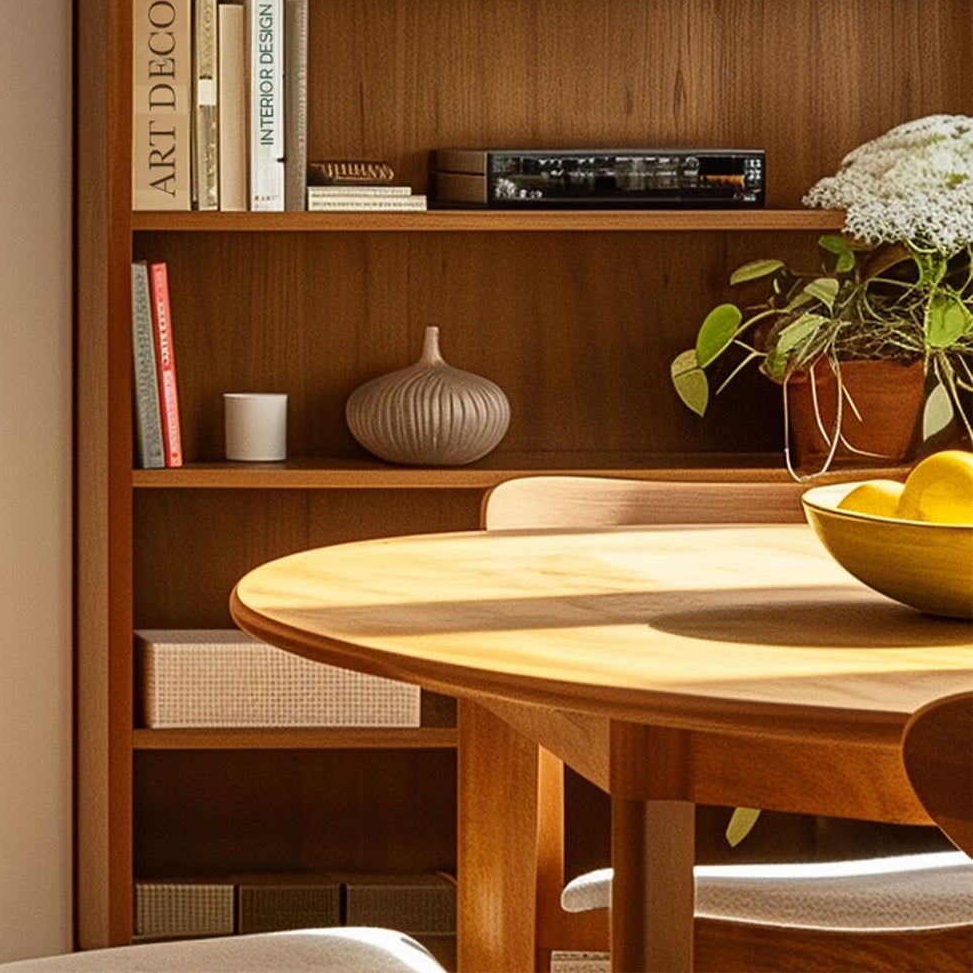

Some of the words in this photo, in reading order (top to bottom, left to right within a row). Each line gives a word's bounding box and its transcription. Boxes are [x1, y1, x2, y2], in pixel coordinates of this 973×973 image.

[147, 0, 177, 111] DECO
[258, 4, 274, 65] DESIGN
[258, 68, 274, 146] INTERIOR
[148, 119, 177, 197] ART
